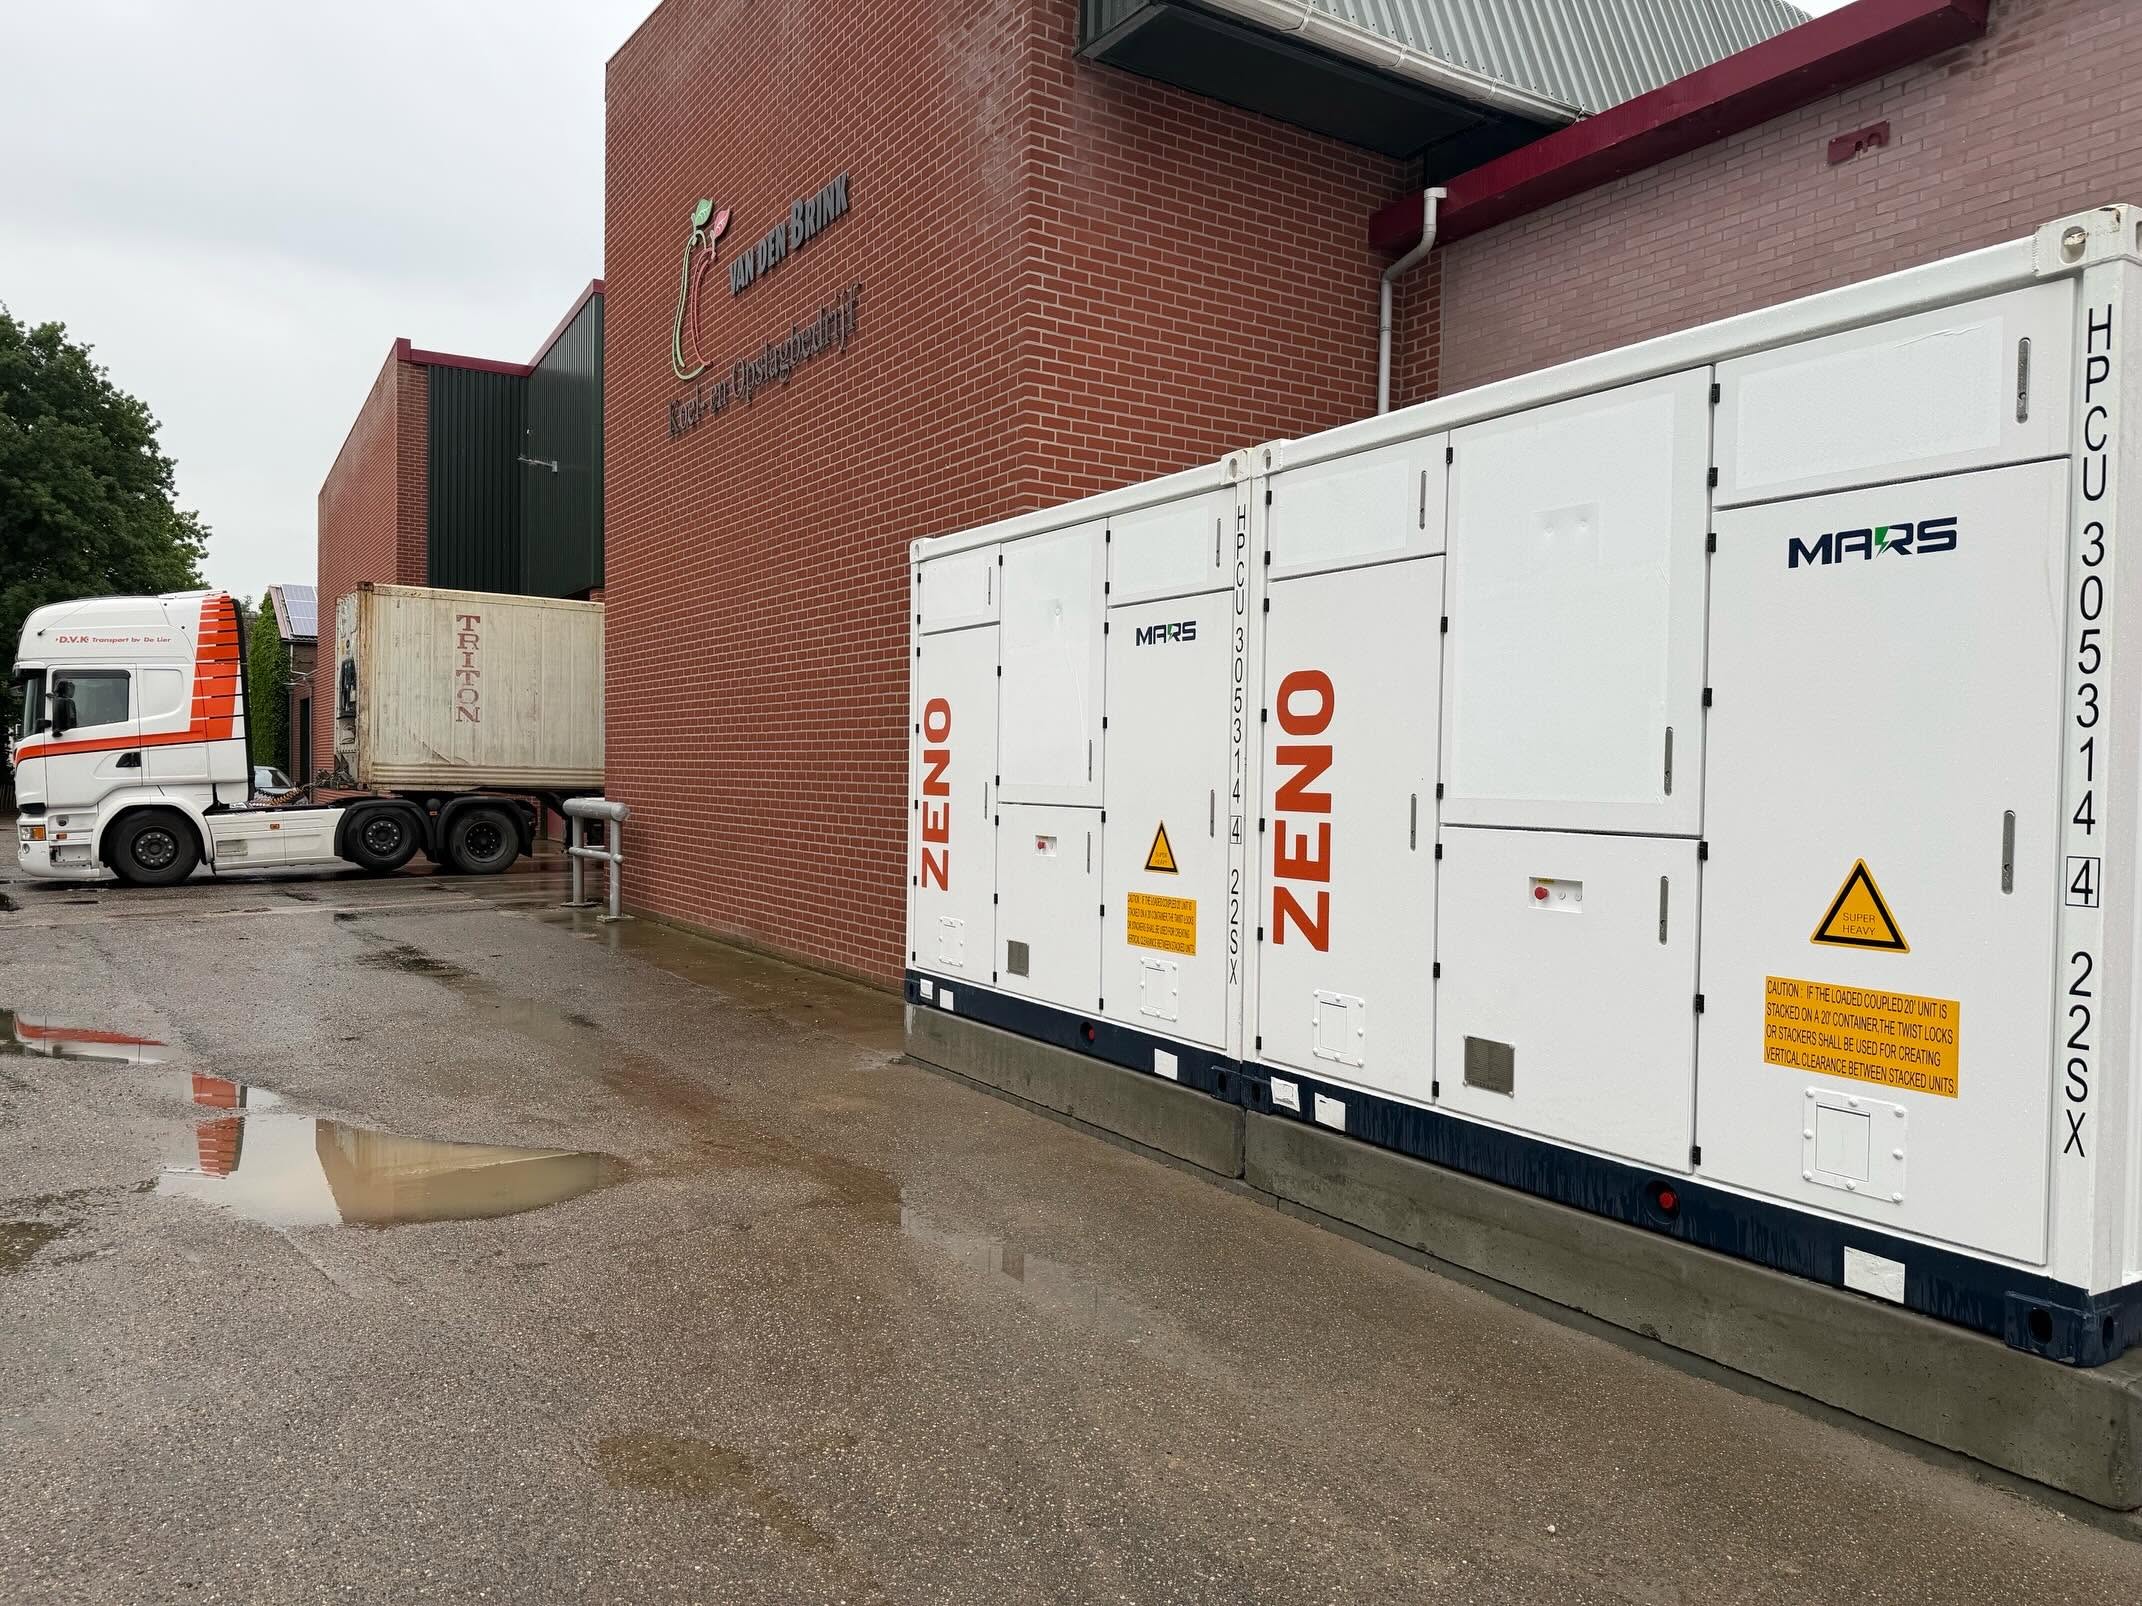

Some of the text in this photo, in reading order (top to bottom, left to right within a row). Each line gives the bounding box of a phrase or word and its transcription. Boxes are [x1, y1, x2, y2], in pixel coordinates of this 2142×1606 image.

[729, 246, 755, 295] VAN
[757, 222, 787, 275] DEN
[711, 380, 728, 412] en
[731, 282, 861, 405] Opslagbedrijf
[1236, 503, 1246, 616] HPCU
[1789, 516, 1958, 569] MARS
[92, 636, 130, 644] Transport
[1135, 620, 1197, 647] MARS
[455, 614, 481, 723] TRITON
[1232, 626, 1245, 804] 305314
[2065, 303, 2112, 1158] HPCU 305314 4 22SX
[921, 698, 951, 891] ZENO
[1272, 669, 1334, 952] ZENO
[1229, 868, 1239, 985] 22SX
[1842, 912, 1876, 923] SUPER
[1842, 924, 1876, 936] HEAVY
[1767, 1002, 1800, 1020] STACKED
[1802, 1007, 1812, 1022] ON
[1815, 1009, 1819, 1022] A
[1898, 1022, 1923, 1040] TWIST
[1925, 1026, 1953, 1044] LOCKS
[1807, 986, 1813, 999] IF
[1816, 986, 1829, 1002] THE
[1832, 988, 1862, 1007] LOADED
[1865, 993, 1902, 1012] COUPLED
[1918, 1001, 1937, 1017] UNIT
[1939, 1004, 1947, 1019] IS
[1766, 1025, 1940, 1067] OR STACKERS SHALL BE USED FOR CREATING
[1766, 1047, 1800, 1065] VERTICAL
[1802, 1052, 1846, 1073] CLEARANCE
[1849, 1061, 1886, 1080] BETWEEN
[1889, 1069, 1926, 1088] STACKED
